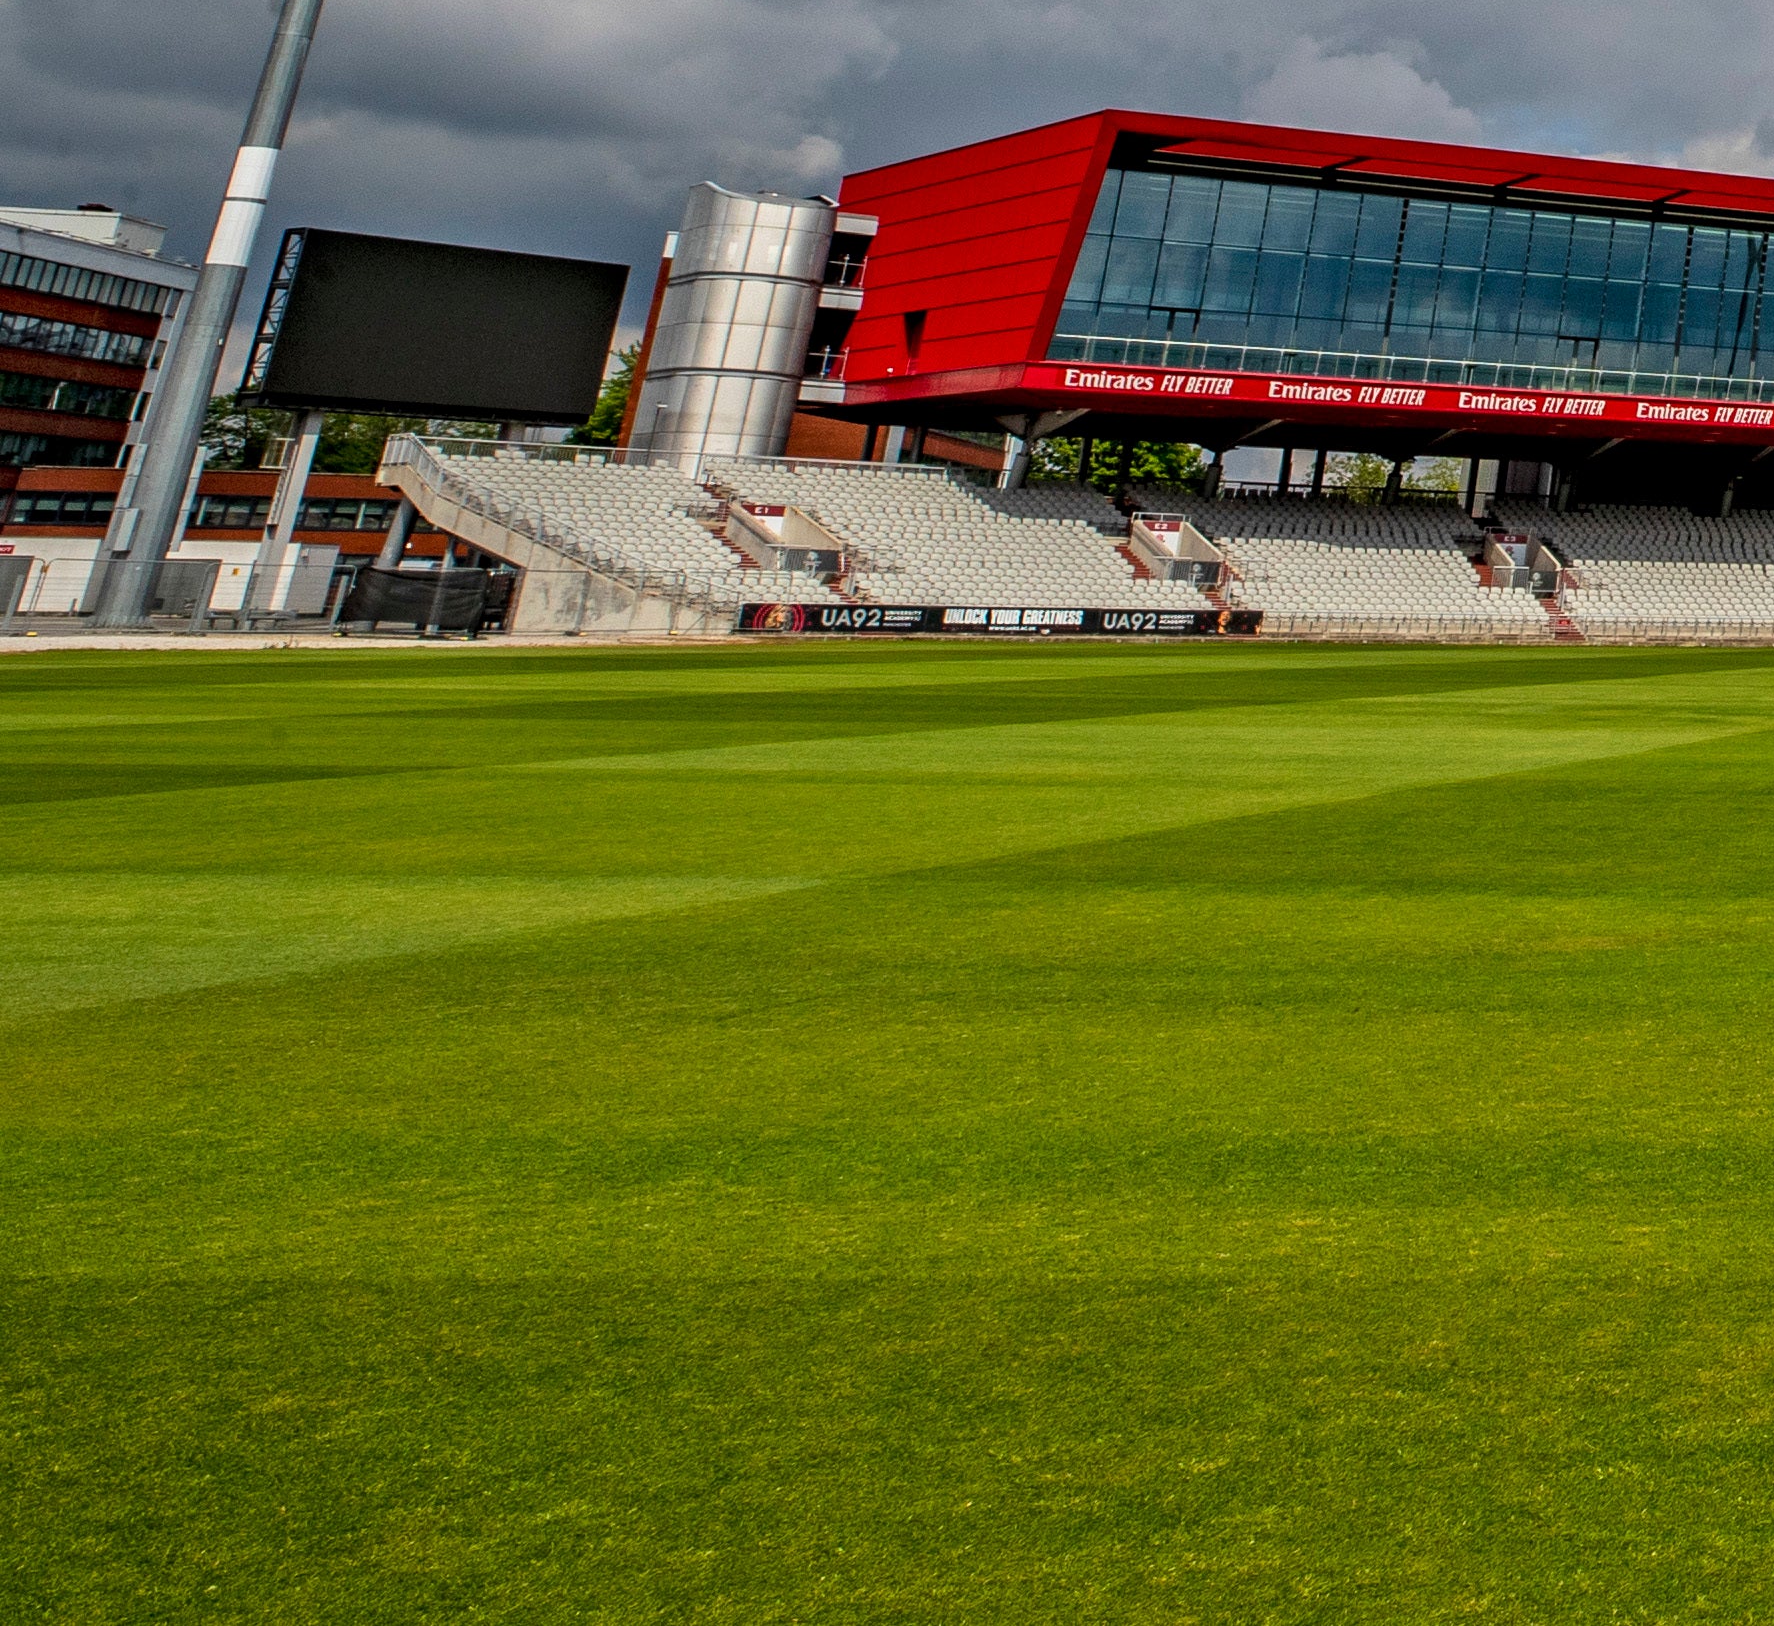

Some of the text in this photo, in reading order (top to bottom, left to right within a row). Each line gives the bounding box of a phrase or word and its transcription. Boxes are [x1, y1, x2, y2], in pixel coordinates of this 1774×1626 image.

[1064, 369, 1234, 395] Emirates FLY BETTER
[1268, 381, 1426, 406] Emirates FLY BETTER
[1458, 392, 1605, 416] Emirates FLY BETTER
[1636, 402, 1773, 425] Emirates FLY BETTER
[754, 506, 769, 514] E1
[821, 608, 882, 627] UA92
[943, 608, 1084, 625] UNLOCK YOUR GREATNESS
[1103, 612, 1156, 630] UA92
